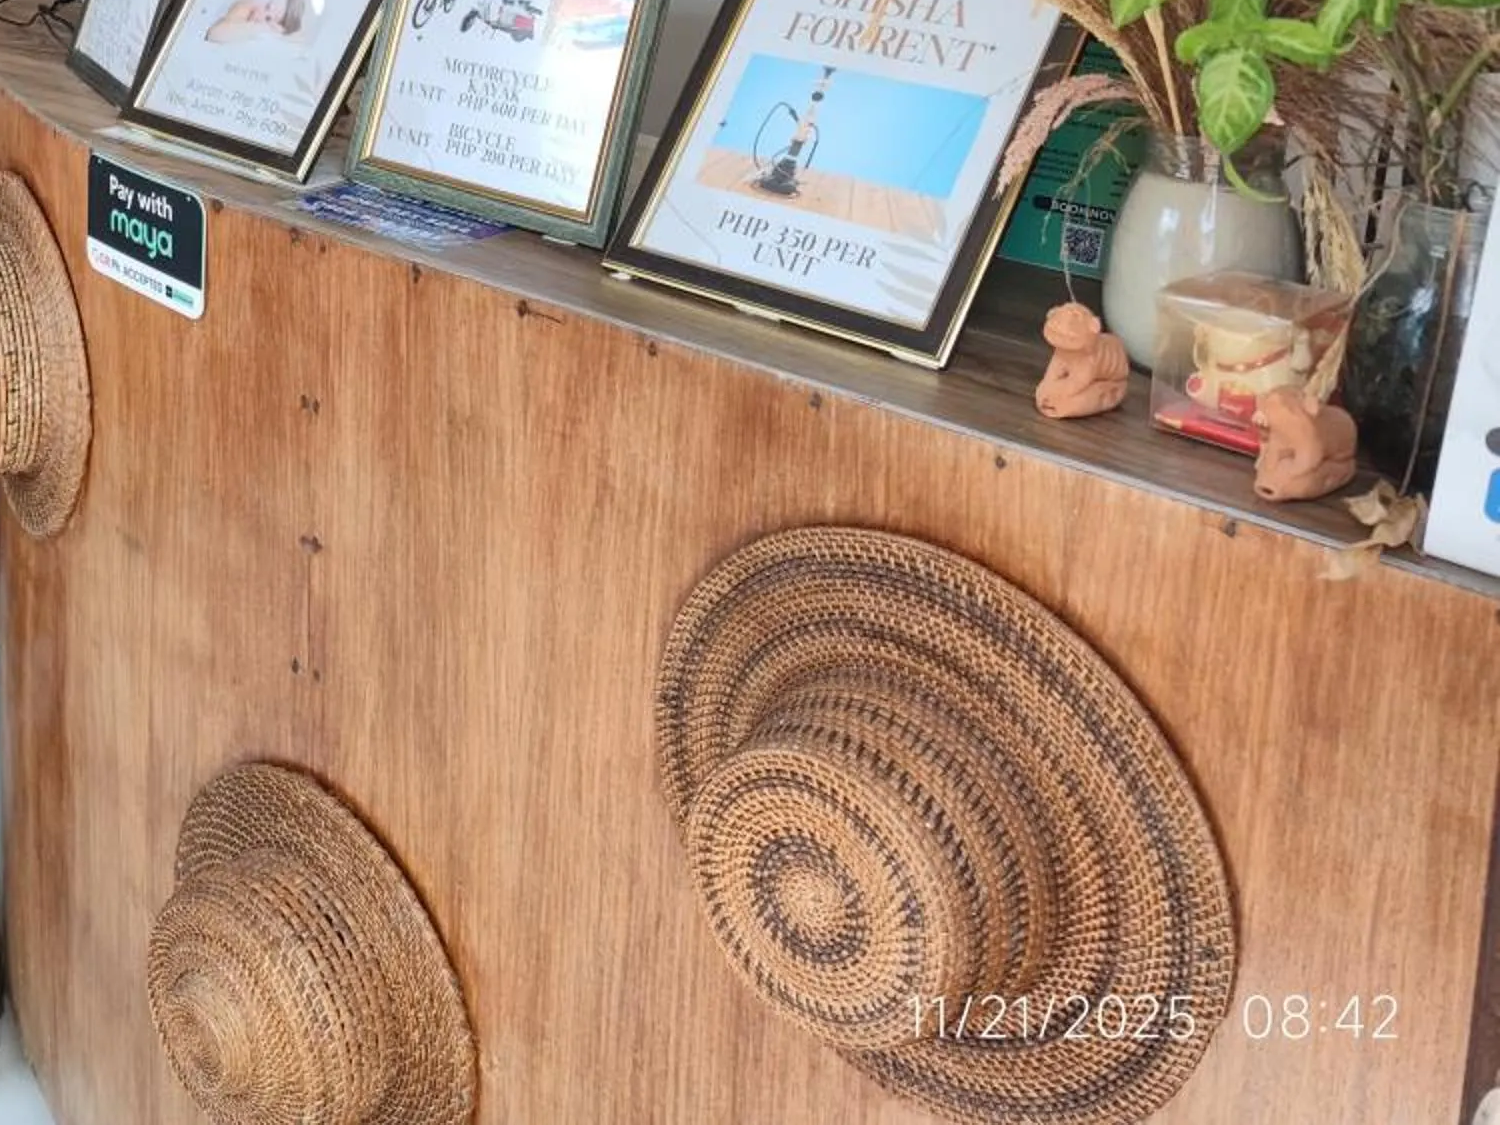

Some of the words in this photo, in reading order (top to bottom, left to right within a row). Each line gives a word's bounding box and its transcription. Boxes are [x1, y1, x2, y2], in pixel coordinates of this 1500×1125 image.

[783, 11, 863, 52] FOR
[409, 82, 446, 102] UNIT
[445, 57, 556, 92] MOTORCYCLE
[467, 79, 520, 103] KAYAK
[458, 92, 490, 112] PHP
[491, 102, 517, 119] 600
[520, 106, 552, 126] PER
[449, 123, 516, 151] BICYCLE
[445, 139, 477, 158] PHP
[509, 154, 542, 174] PER
[109, 174, 135, 209] Pay
[137, 191, 173, 222] with
[110, 208, 173, 259] maya
[717, 209, 770, 239] PHP
[774, 226, 818, 252] 350
[822, 237, 877, 269] PER
[752, 241, 821, 276] UNIT
